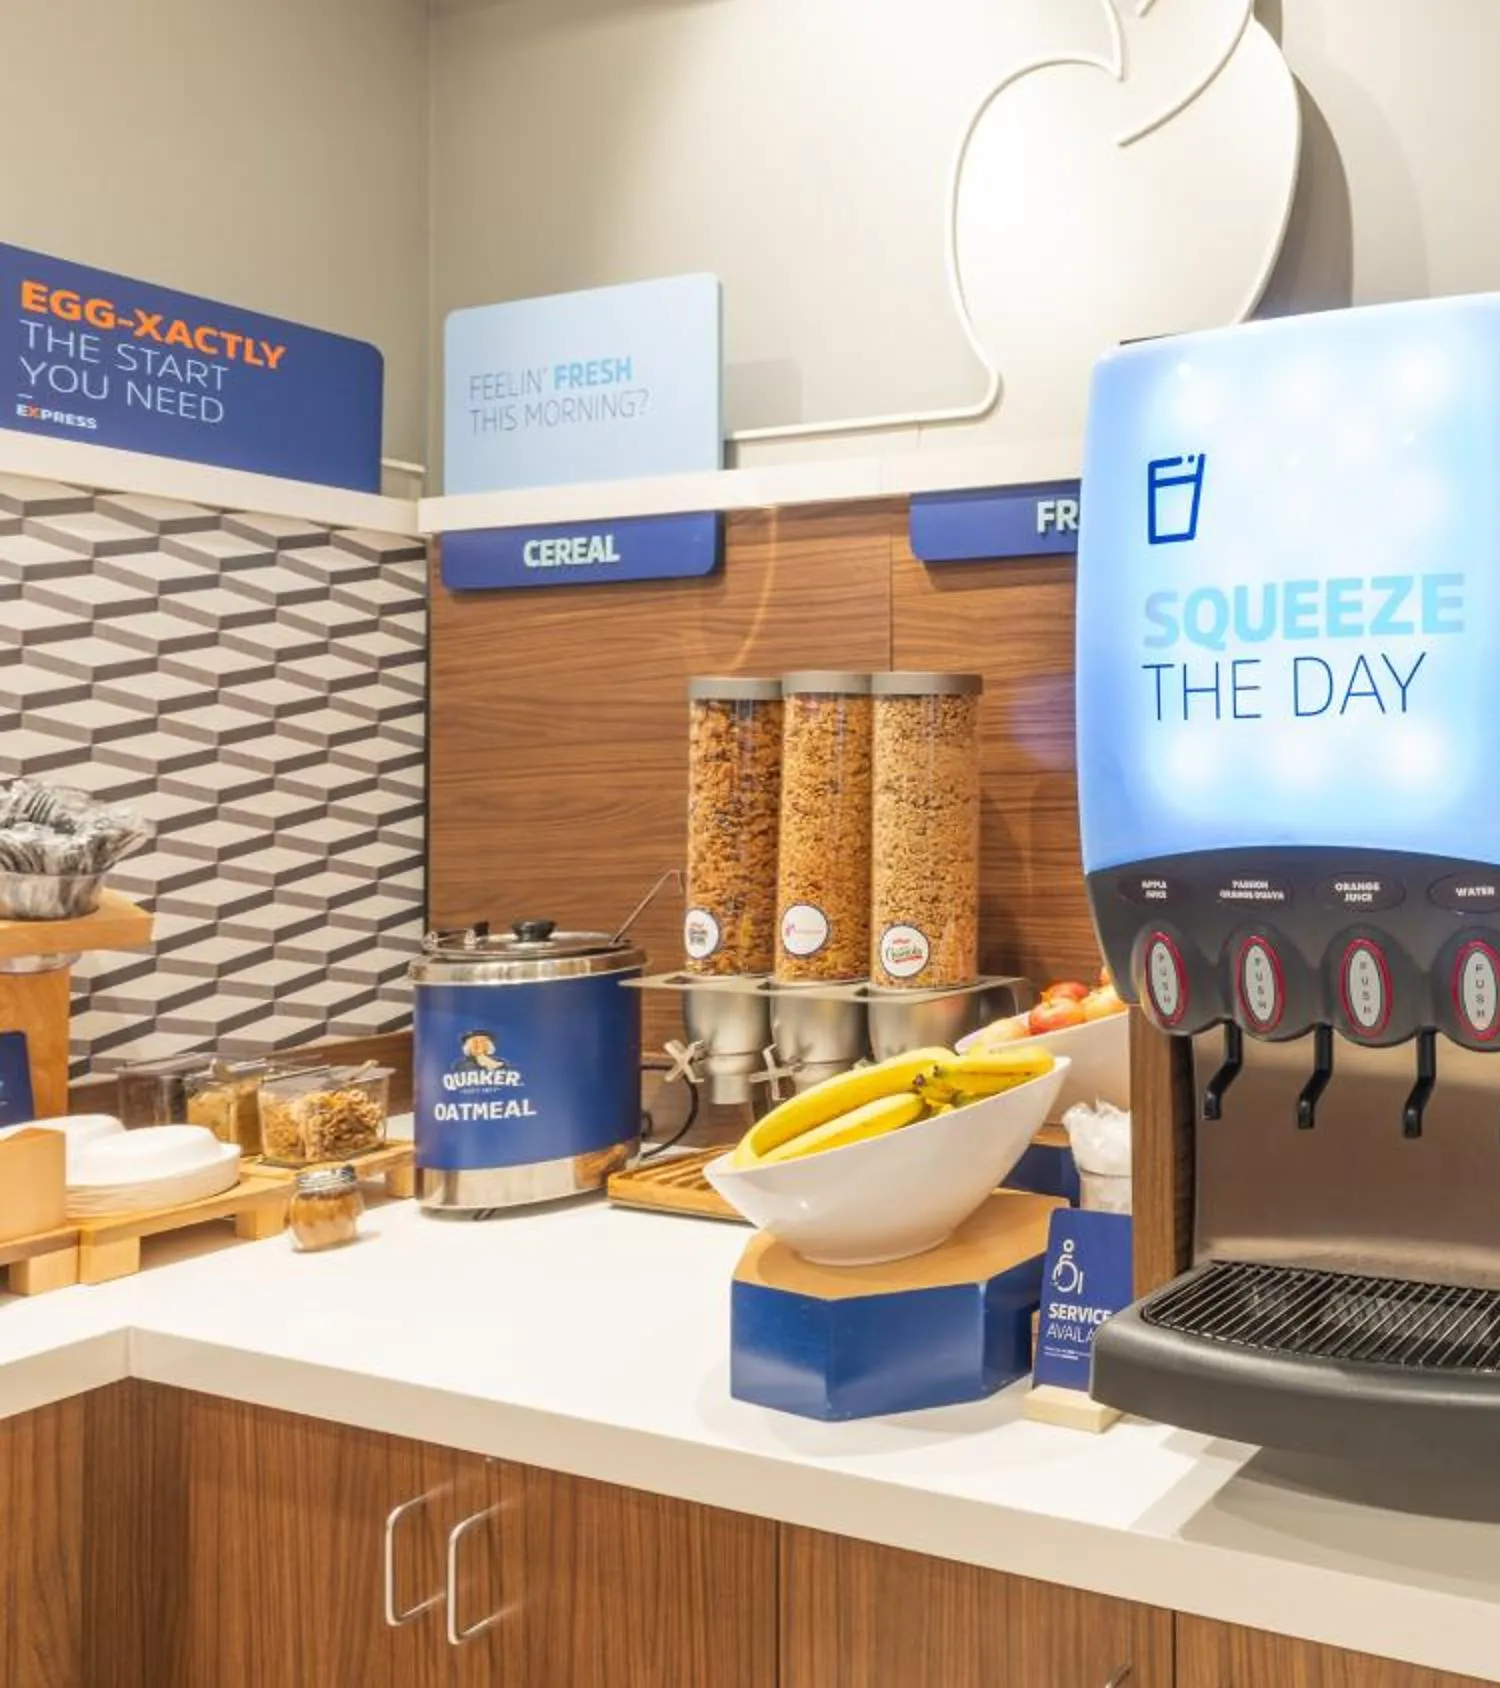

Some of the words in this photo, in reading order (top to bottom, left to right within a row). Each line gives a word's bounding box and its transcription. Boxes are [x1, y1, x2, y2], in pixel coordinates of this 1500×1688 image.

[20, 279, 287, 370] EGG-XACTLY
[19, 318, 102, 364] THE
[114, 342, 231, 391] START
[553, 356, 633, 391] FRESH
[19, 355, 110, 400] YOU
[126, 380, 226, 424] NEED
[469, 406, 519, 436] THIS
[524, 388, 652, 430] MORNING?
[16, 403, 98, 430] EXPRESS
[522, 534, 621, 568] CEREAL
[1142, 572, 1466, 651] SQUEEZE
[1141, 657, 1262, 722] THE
[1292, 651, 1428, 719] DAY
[1334, 881, 1381, 892] ORANGE
[1344, 892, 1374, 903] JUICE
[1455, 885, 1496, 898] WATER
[1254, 956, 1269, 1010] PUSH
[1358, 961, 1372, 1015] PUSH
[1474, 963, 1486, 1019] PUSH
[443, 1069, 521, 1091] QUAKER
[434, 1098, 538, 1122] OATMEAL
